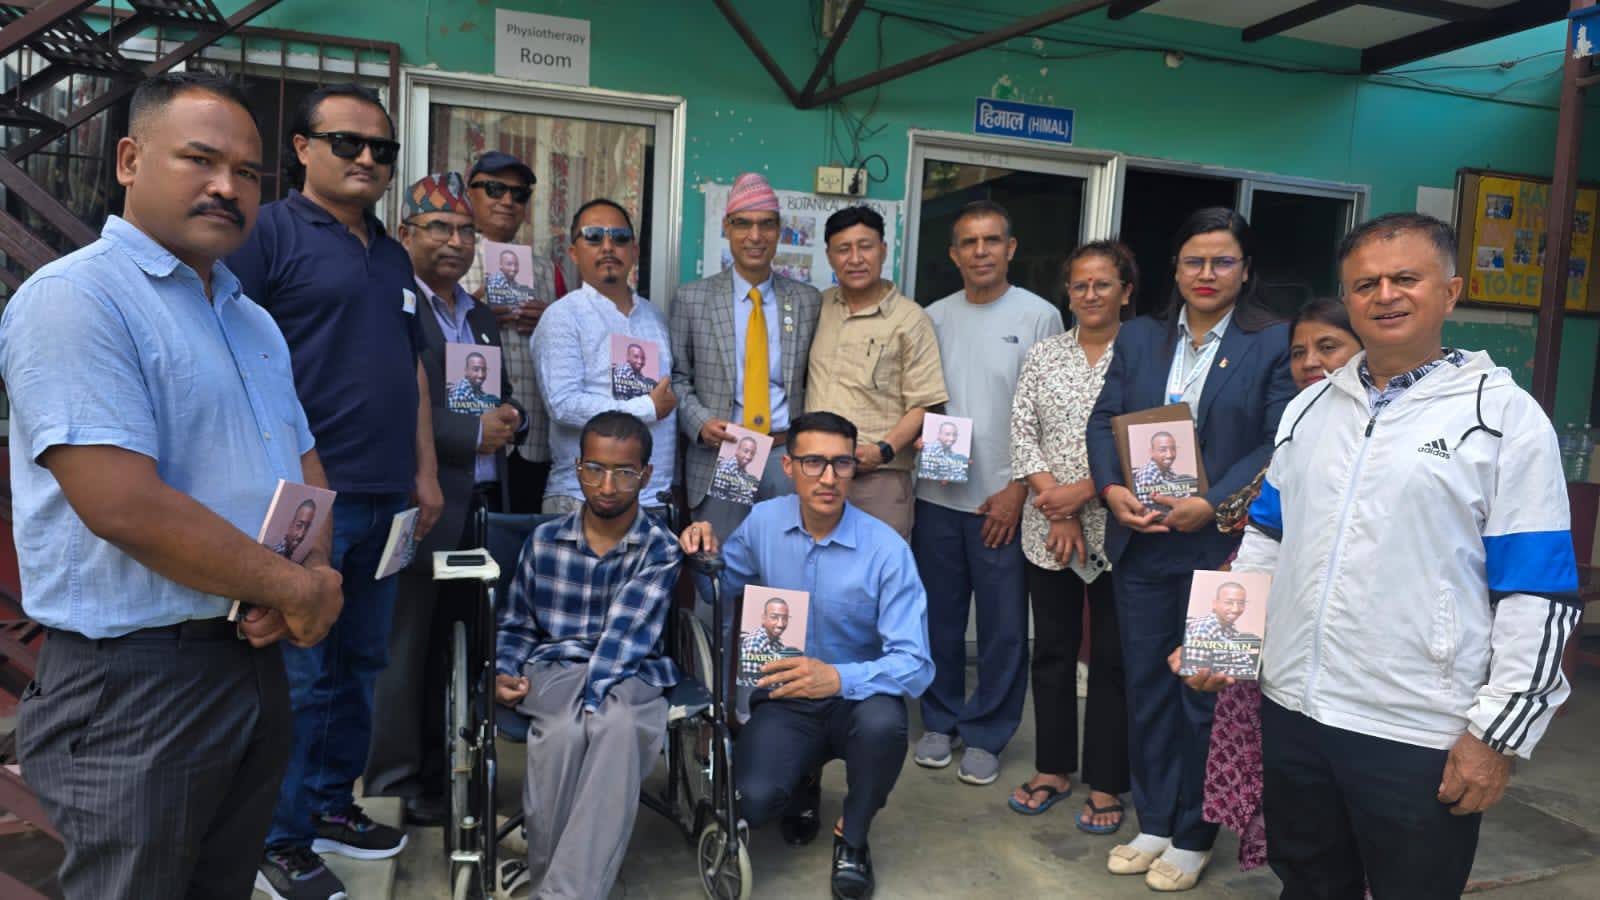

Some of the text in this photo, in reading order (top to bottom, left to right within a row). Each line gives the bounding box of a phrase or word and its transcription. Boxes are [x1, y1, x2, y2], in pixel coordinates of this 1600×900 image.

[506, 23, 585, 45] Physiotherapy
[520, 47, 572, 68] Room
[980, 102, 1069, 139] हिमाल (HIMAL)
[1417, 447, 1450, 460] adidas
